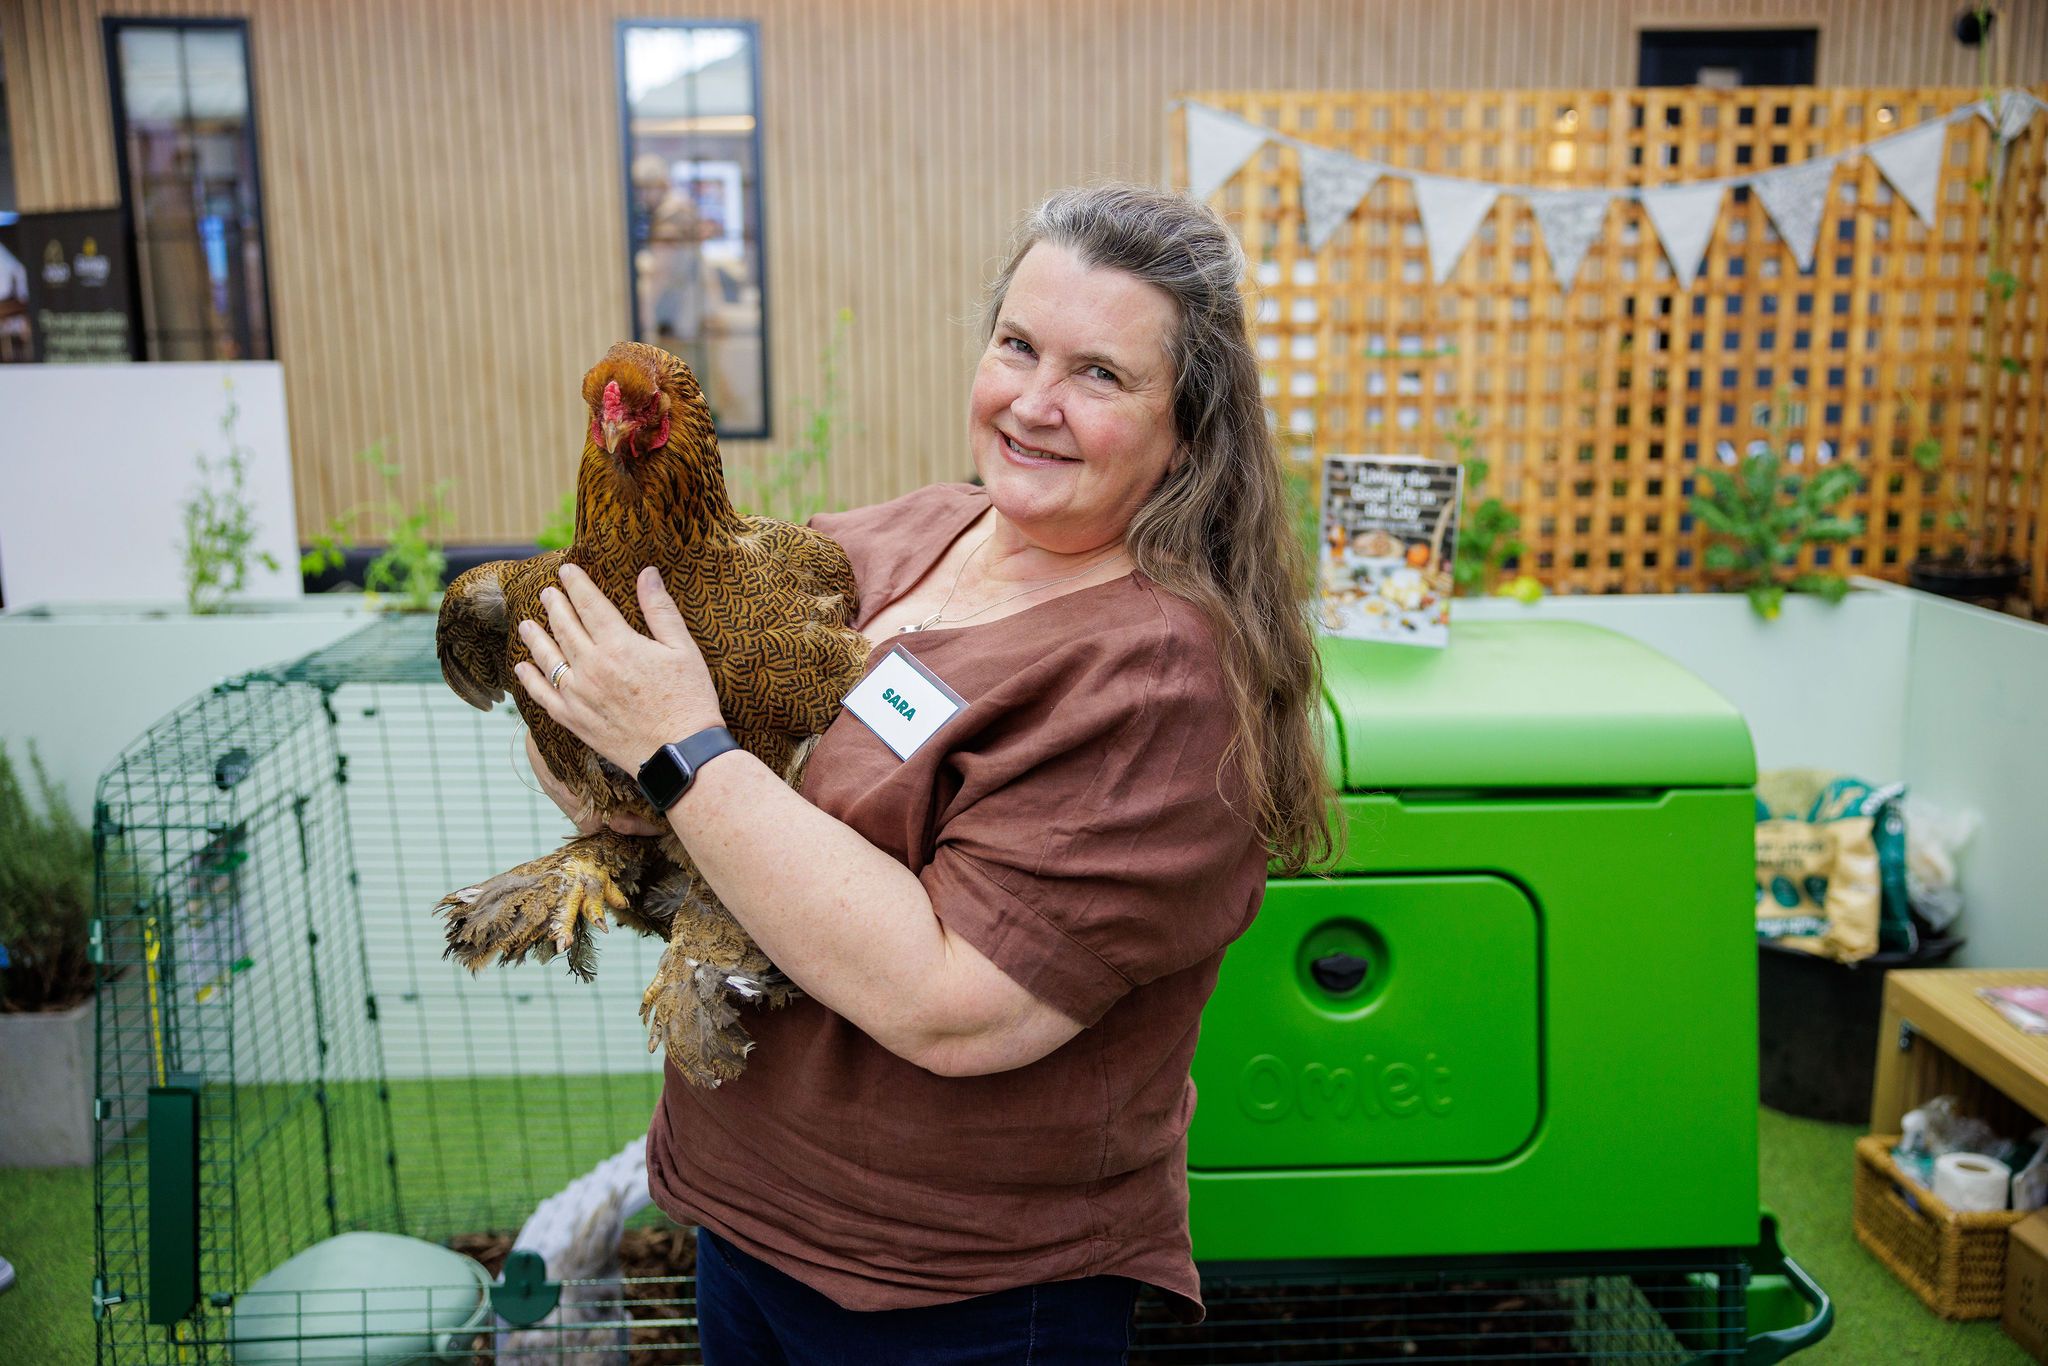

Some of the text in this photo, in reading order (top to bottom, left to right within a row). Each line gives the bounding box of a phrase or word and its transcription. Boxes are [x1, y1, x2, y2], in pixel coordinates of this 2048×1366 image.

[1358, 467, 1431, 491] Living the
[1352, 485, 1436, 505] Good Life in
[1364, 502, 1420, 522] the City
[882, 688, 916, 721] SARA
[1238, 1053, 1454, 1123] Omlet
